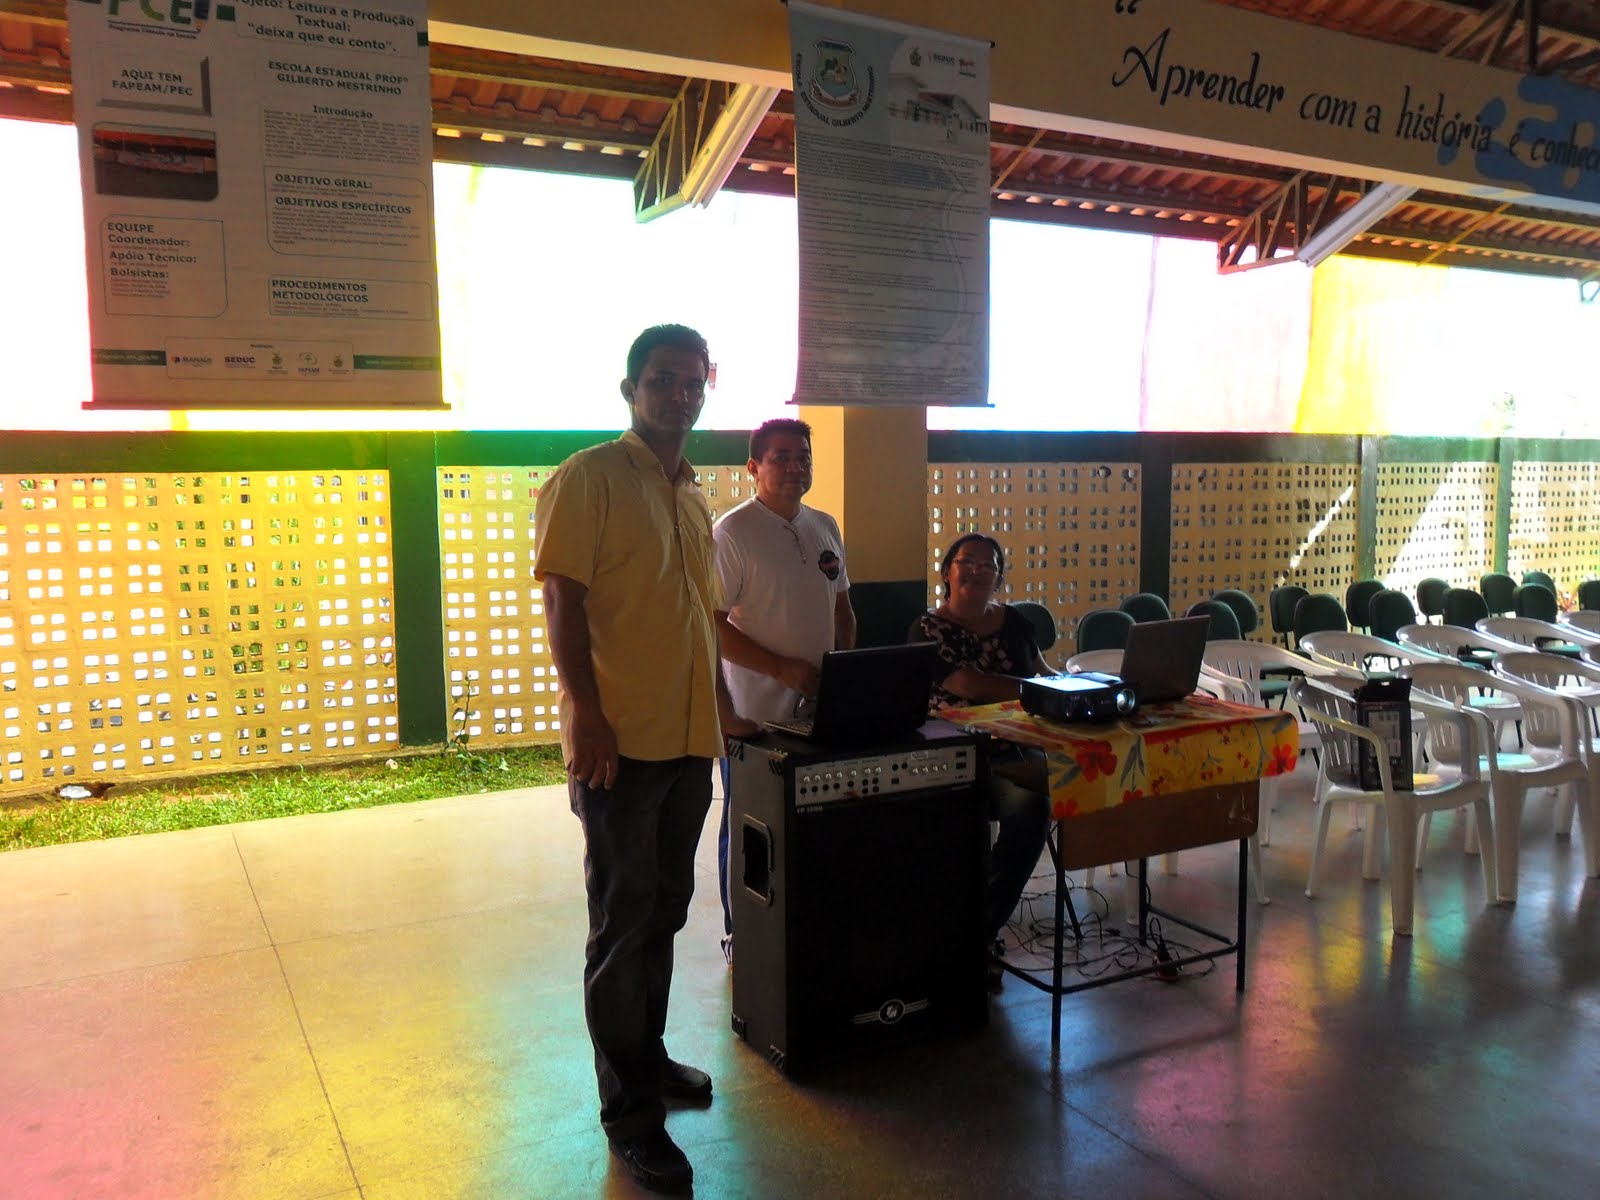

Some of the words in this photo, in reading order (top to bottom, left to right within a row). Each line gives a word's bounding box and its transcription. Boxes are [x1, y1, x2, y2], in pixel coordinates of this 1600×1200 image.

[288, 1, 336, 15] Leitura
[340, 8, 348, 17] e
[352, 9, 414, 27] Produção
[295, 15, 352, 32] Textual:
[298, 31, 324, 42] que
[328, 36, 344, 45] eu
[121, 69, 153, 81] AQUI
[157, 72, 183, 83] TEM
[268, 60, 312, 74] ESCOLA
[316, 66, 372, 81] ESTADUAL
[112, 80, 193, 96] FAPEAM/PEC
[277, 73, 334, 88] GILBERTO
[337, 81, 402, 95] MESTRINHO
[1111, 27, 1285, 112] Aprender
[1299, 93, 1357, 128] com
[1364, 104, 1382, 134] a
[1396, 84, 1492, 152] história
[312, 104, 373, 119] Introdução
[831, 111, 864, 127] GILBERTO
[275, 173, 331, 186] OBJETIVO
[334, 178, 373, 189] GERAL:
[275, 196, 338, 209] OBJETIVOS
[342, 200, 412, 214] ESPECÍFICOS
[107, 222, 154, 233] EQUIPE
[108, 234, 191, 247] Coordenador:
[147, 252, 197, 263] Técnico:
[110, 267, 169, 279] Bolsistas:
[271, 279, 368, 292] PROCEDIMENTOS
[272, 290, 369, 303] METODOLÓGICOS
